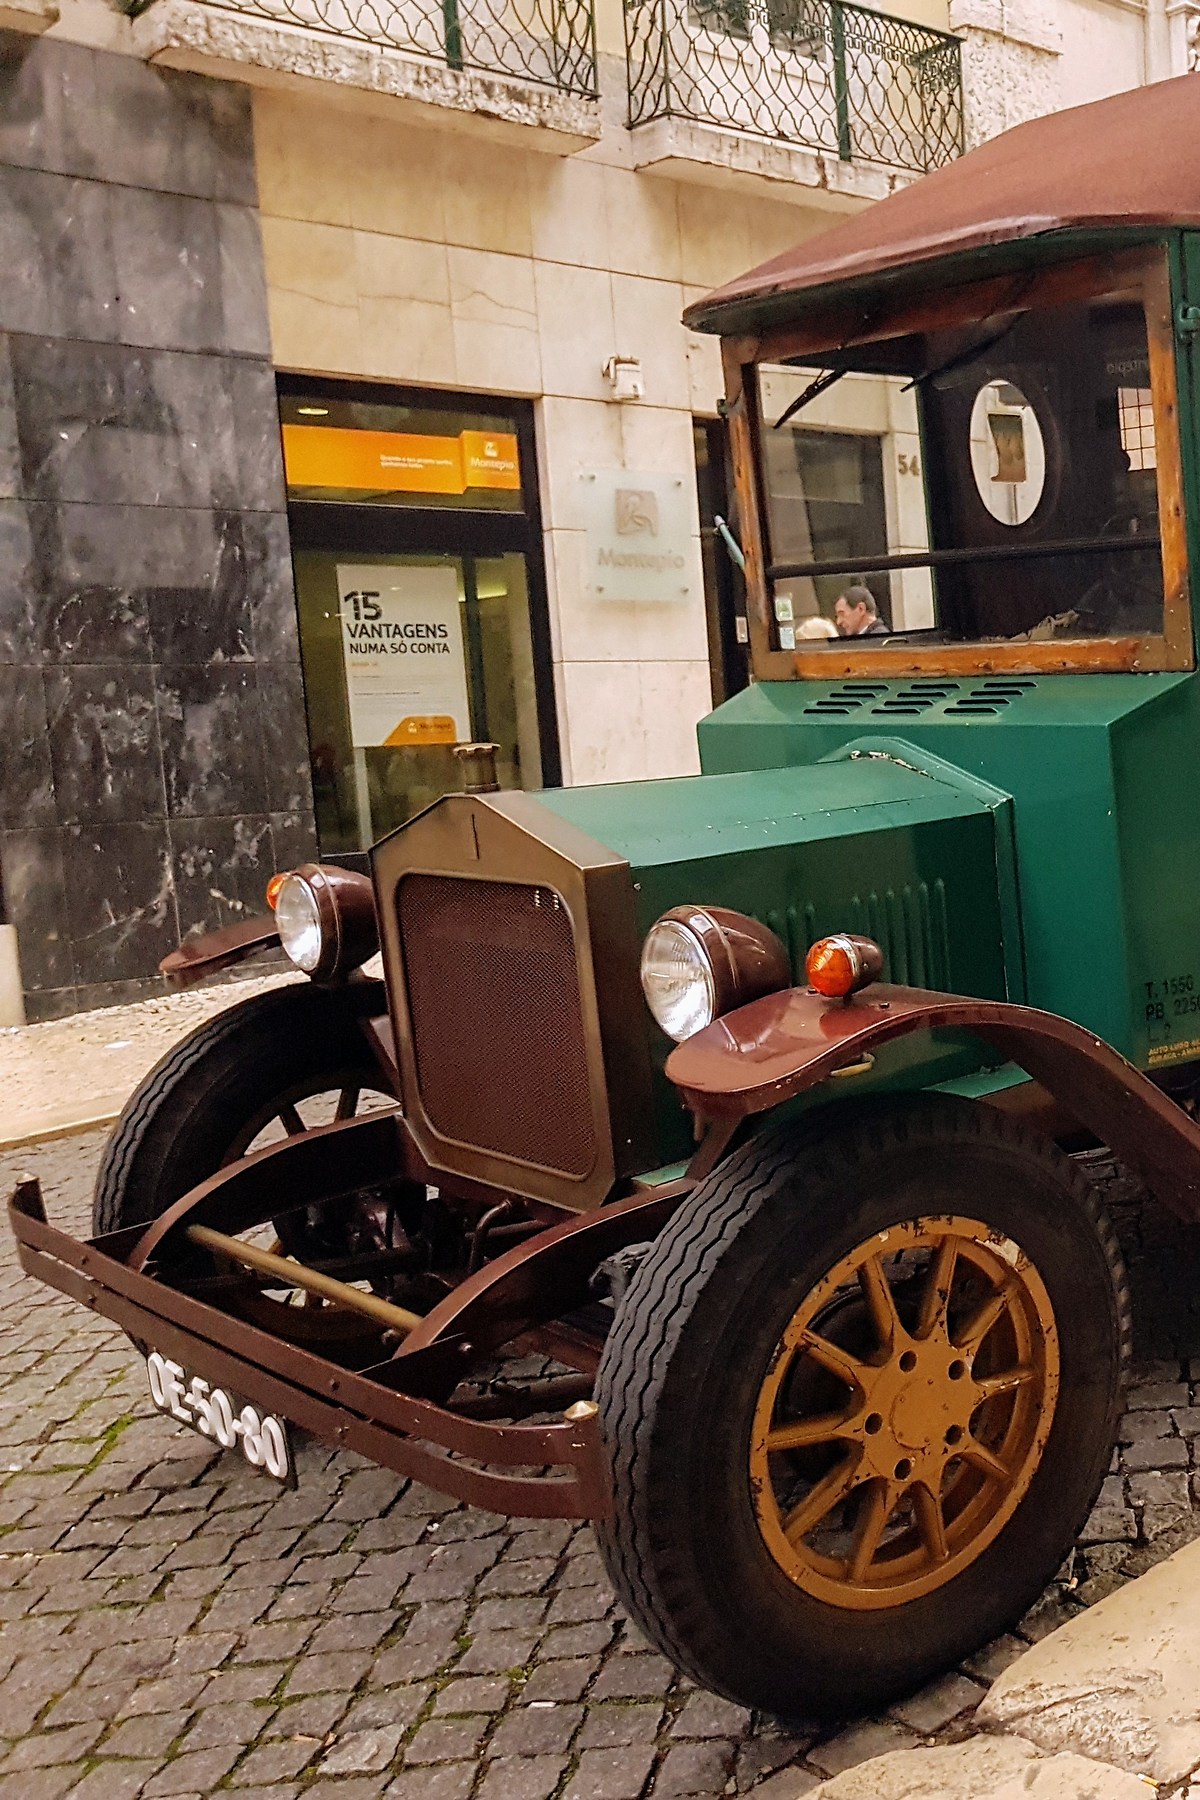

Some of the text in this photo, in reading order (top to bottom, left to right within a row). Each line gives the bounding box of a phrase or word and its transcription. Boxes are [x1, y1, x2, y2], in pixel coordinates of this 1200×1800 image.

[470, 457, 515, 471] Montepio
[898, 454, 920, 476] 54
[598, 547, 685, 573] Montepio
[344, 590, 382, 621] 15
[346, 623, 448, 639] VANTAGENS
[350, 640, 450, 654] NUMA SÓ CONTA
